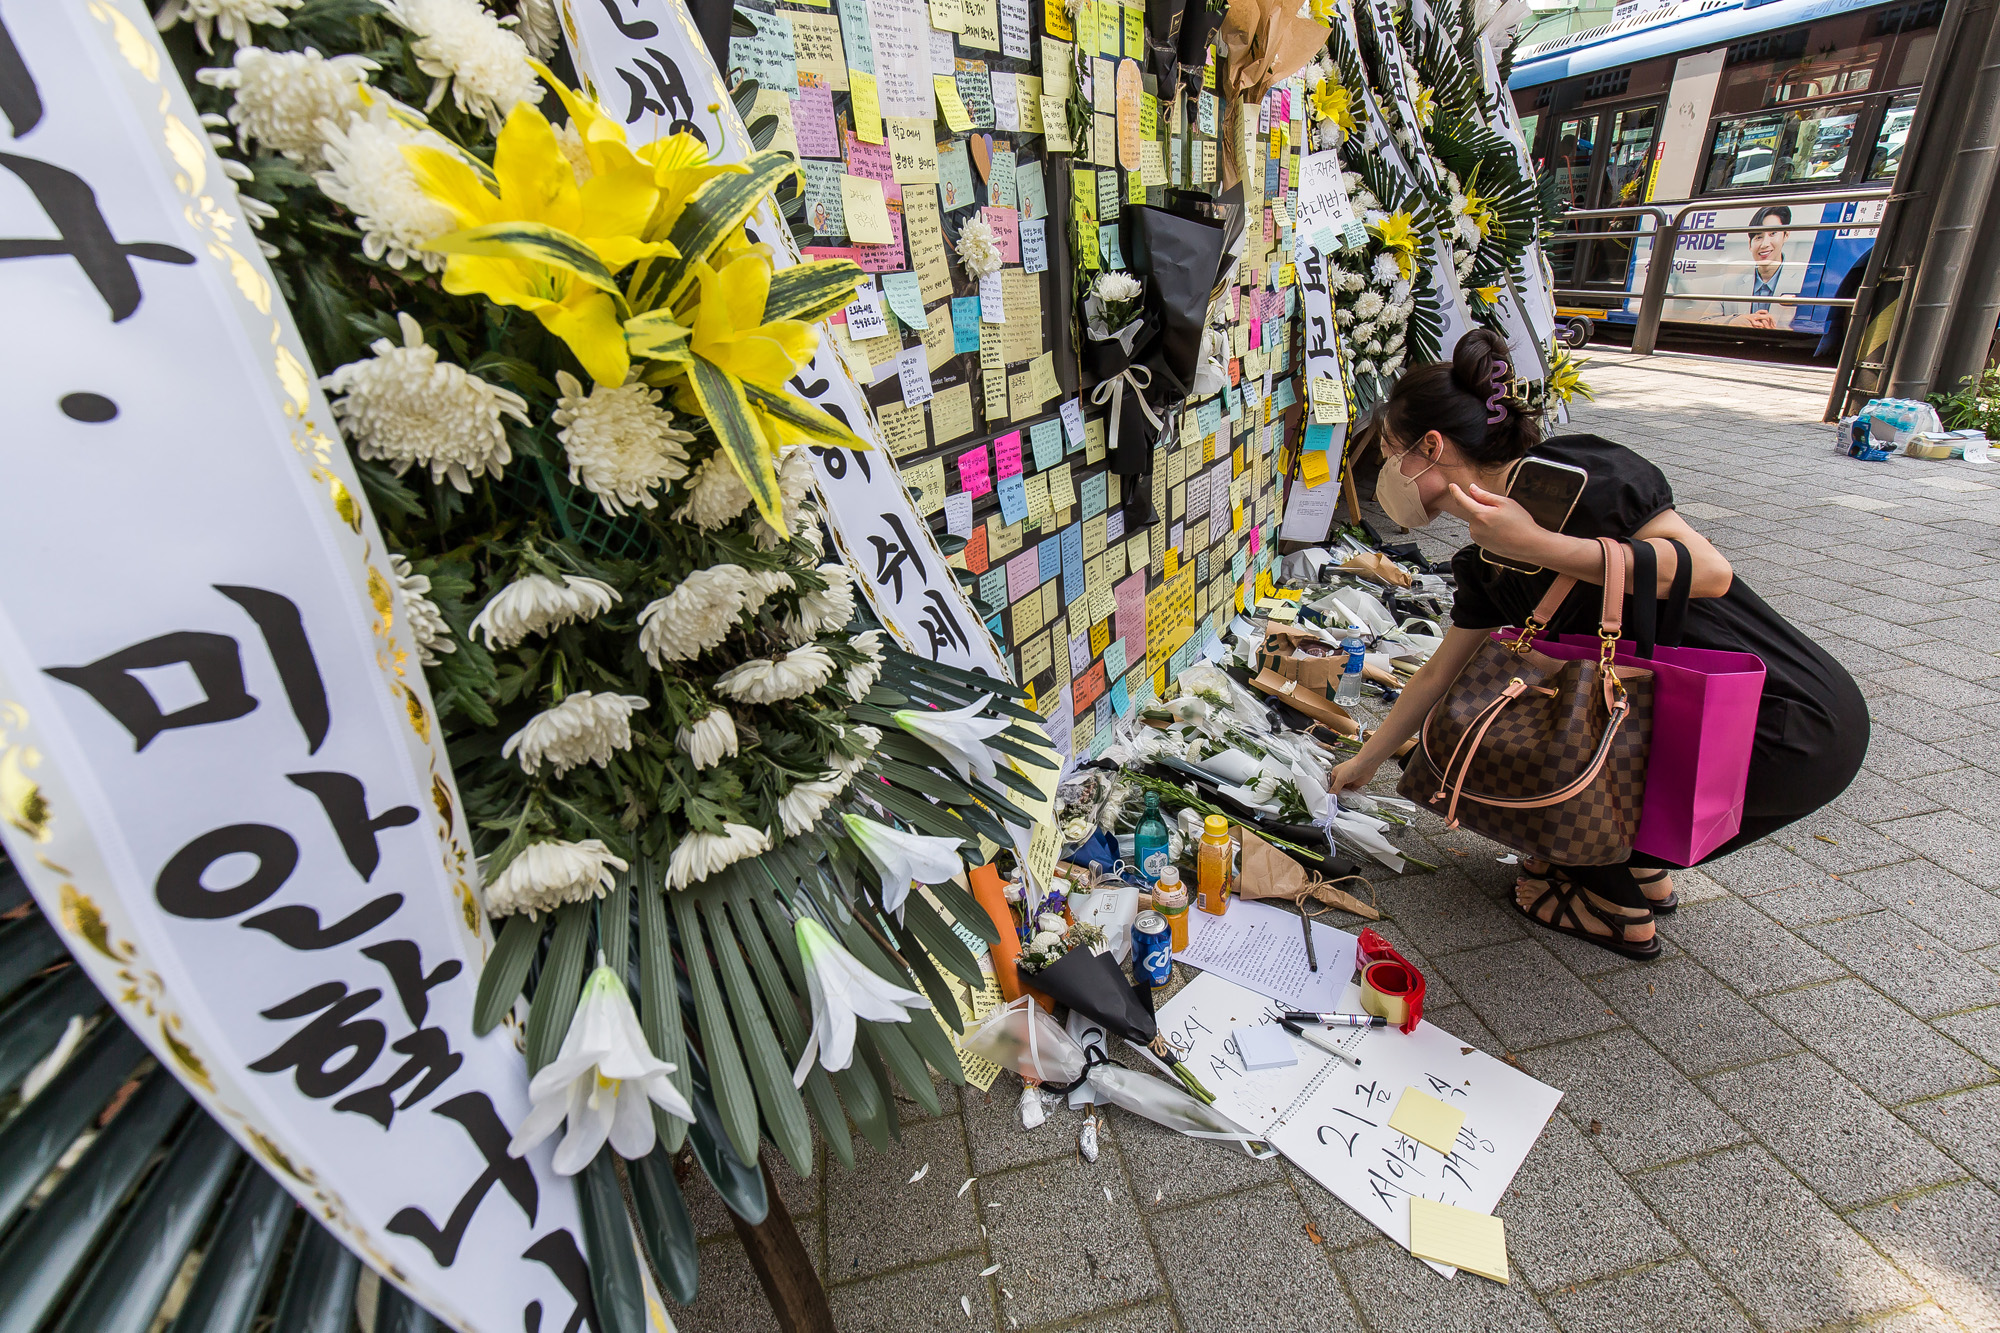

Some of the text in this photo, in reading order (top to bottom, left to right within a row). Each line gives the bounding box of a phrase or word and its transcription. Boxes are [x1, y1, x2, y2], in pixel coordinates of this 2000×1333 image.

[892, 122, 922, 141] 학교에서
[894, 153, 938, 171] 발생한 일이다.
[1301, 157, 1337, 186] 잠재적
[1680, 211, 1717, 230] LIFE
[1676, 232, 1728, 250] PRIDE
[1316, 1106, 1379, 1158] 21
